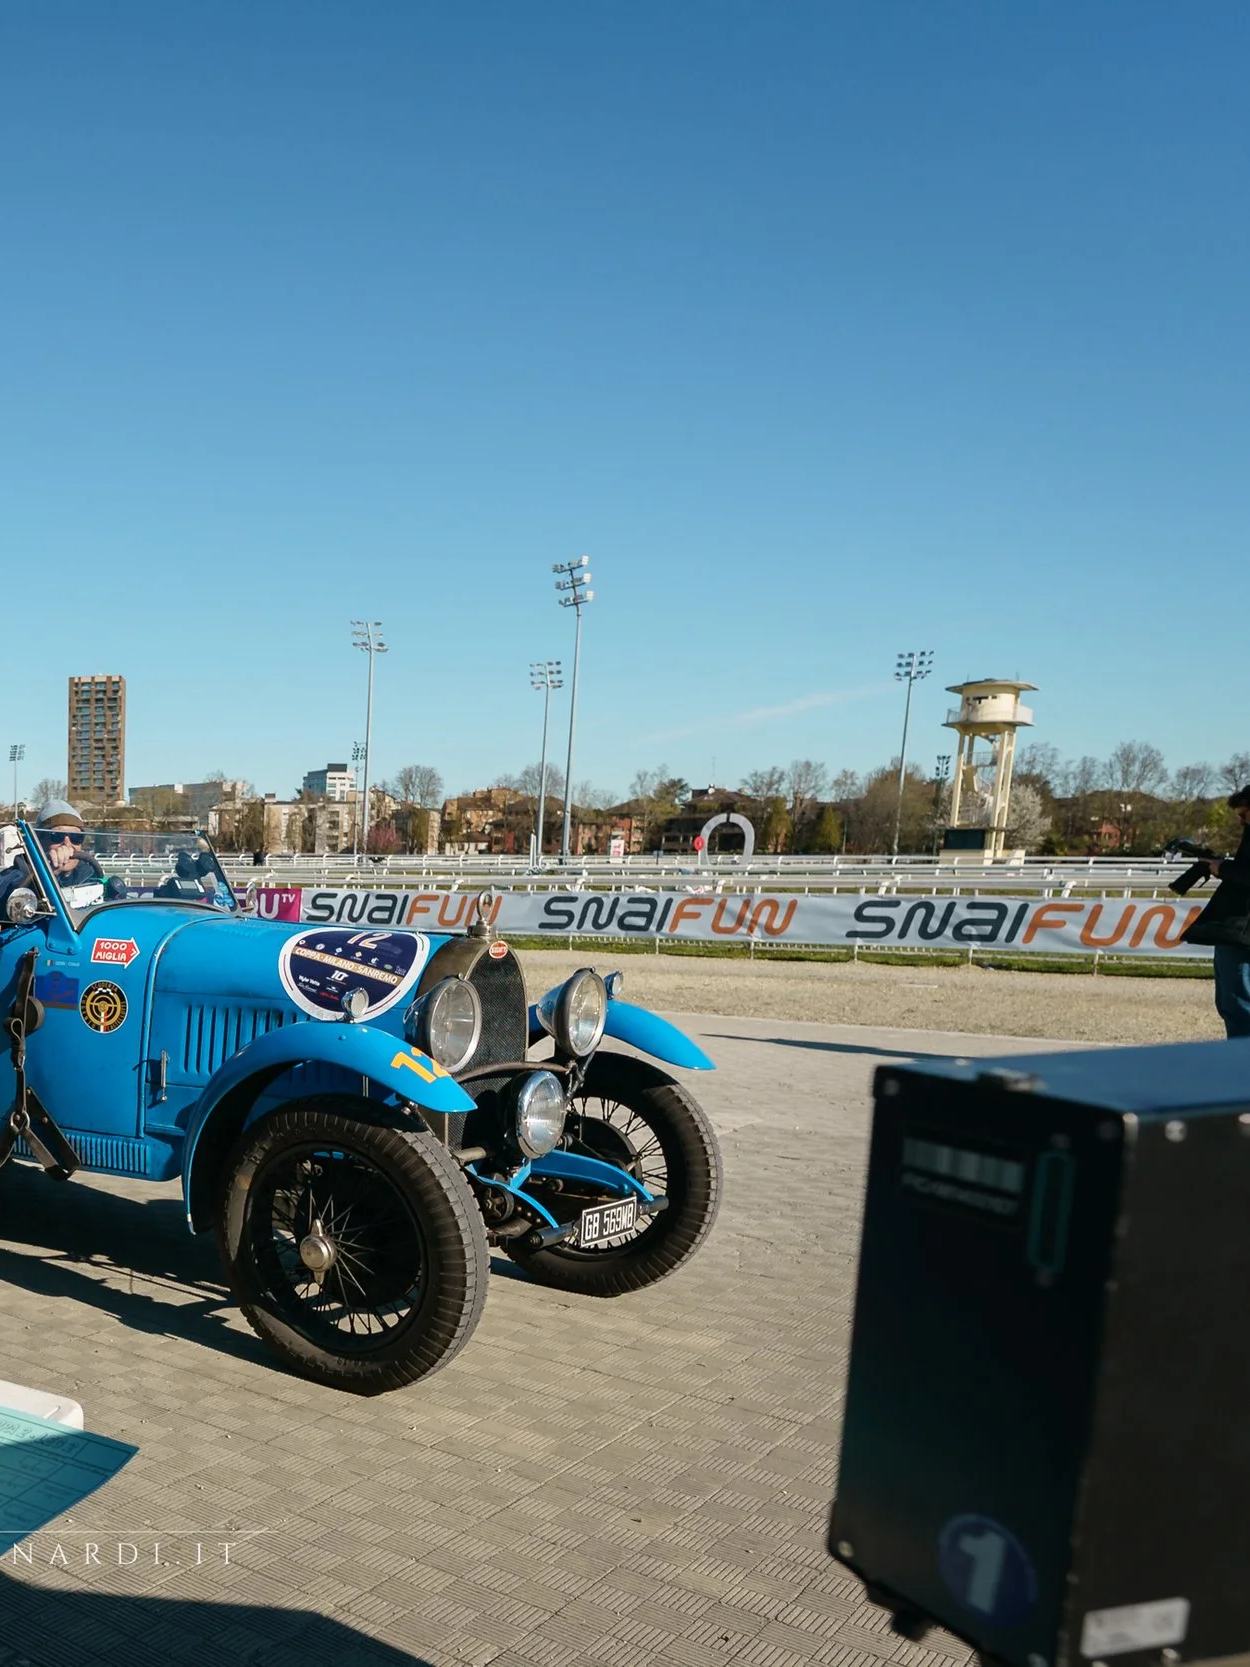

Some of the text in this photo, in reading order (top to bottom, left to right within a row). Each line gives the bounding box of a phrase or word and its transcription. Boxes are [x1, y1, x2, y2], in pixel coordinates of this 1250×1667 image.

[282, 893, 296, 903] TV
[100, 942, 127, 951] 1000
[347, 931, 393, 949] 12
[95, 951, 127, 961] MIGLIA
[295, 947, 321, 961] COPPA
[323, 955, 355, 971] MILANO
[357, 964, 398, 985] SANREMO
[585, 1213, 600, 1241] GB
[957, 1529, 1010, 1616] 1
